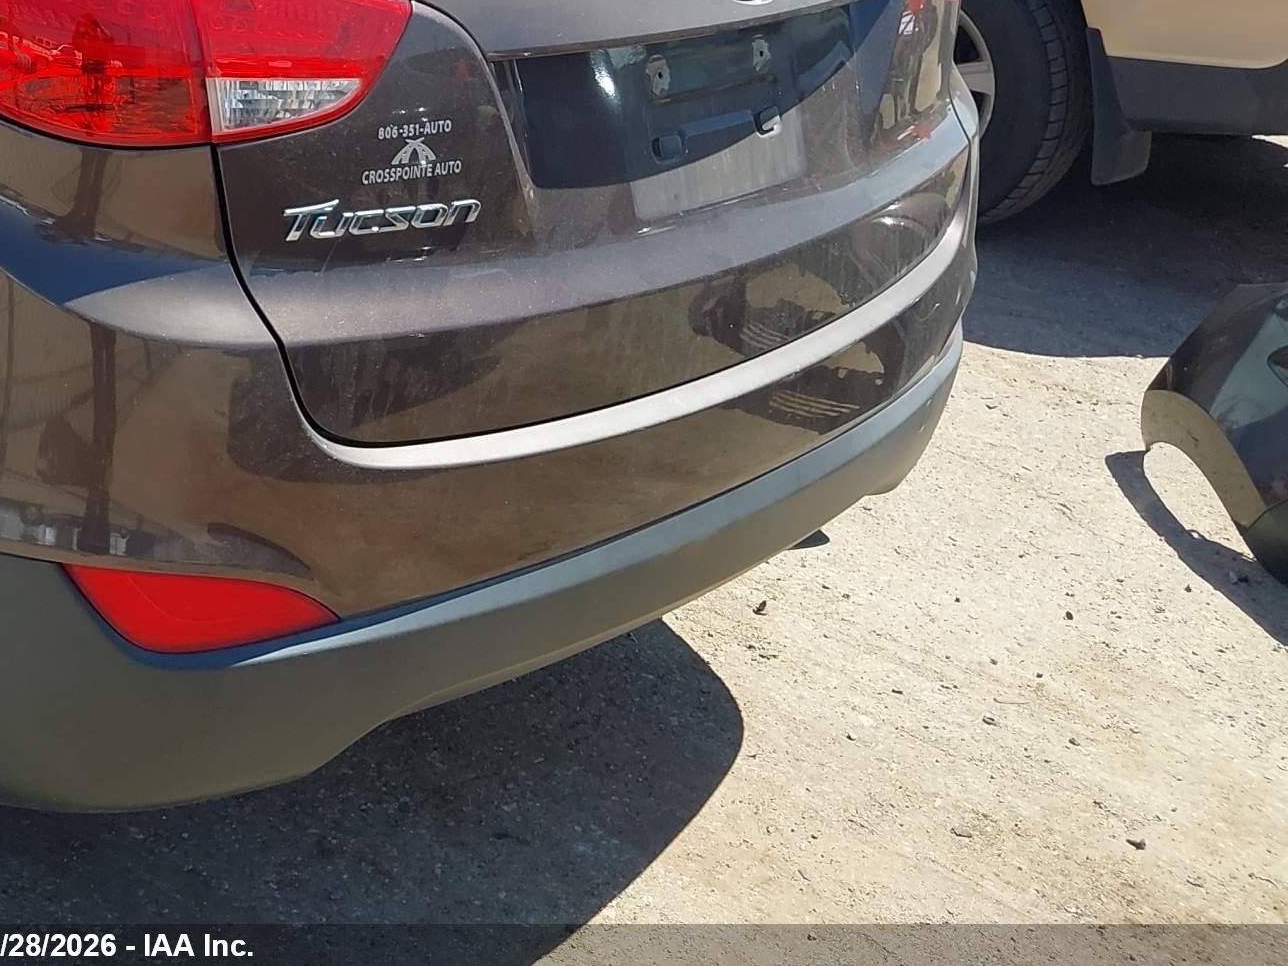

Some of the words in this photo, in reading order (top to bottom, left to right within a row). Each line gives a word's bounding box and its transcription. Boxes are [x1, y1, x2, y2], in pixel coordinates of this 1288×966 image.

[378, 120, 452, 139] 806-351-AUTO
[362, 164, 433, 185] CROSSPOINTE
[434, 160, 462, 176] AUTO
